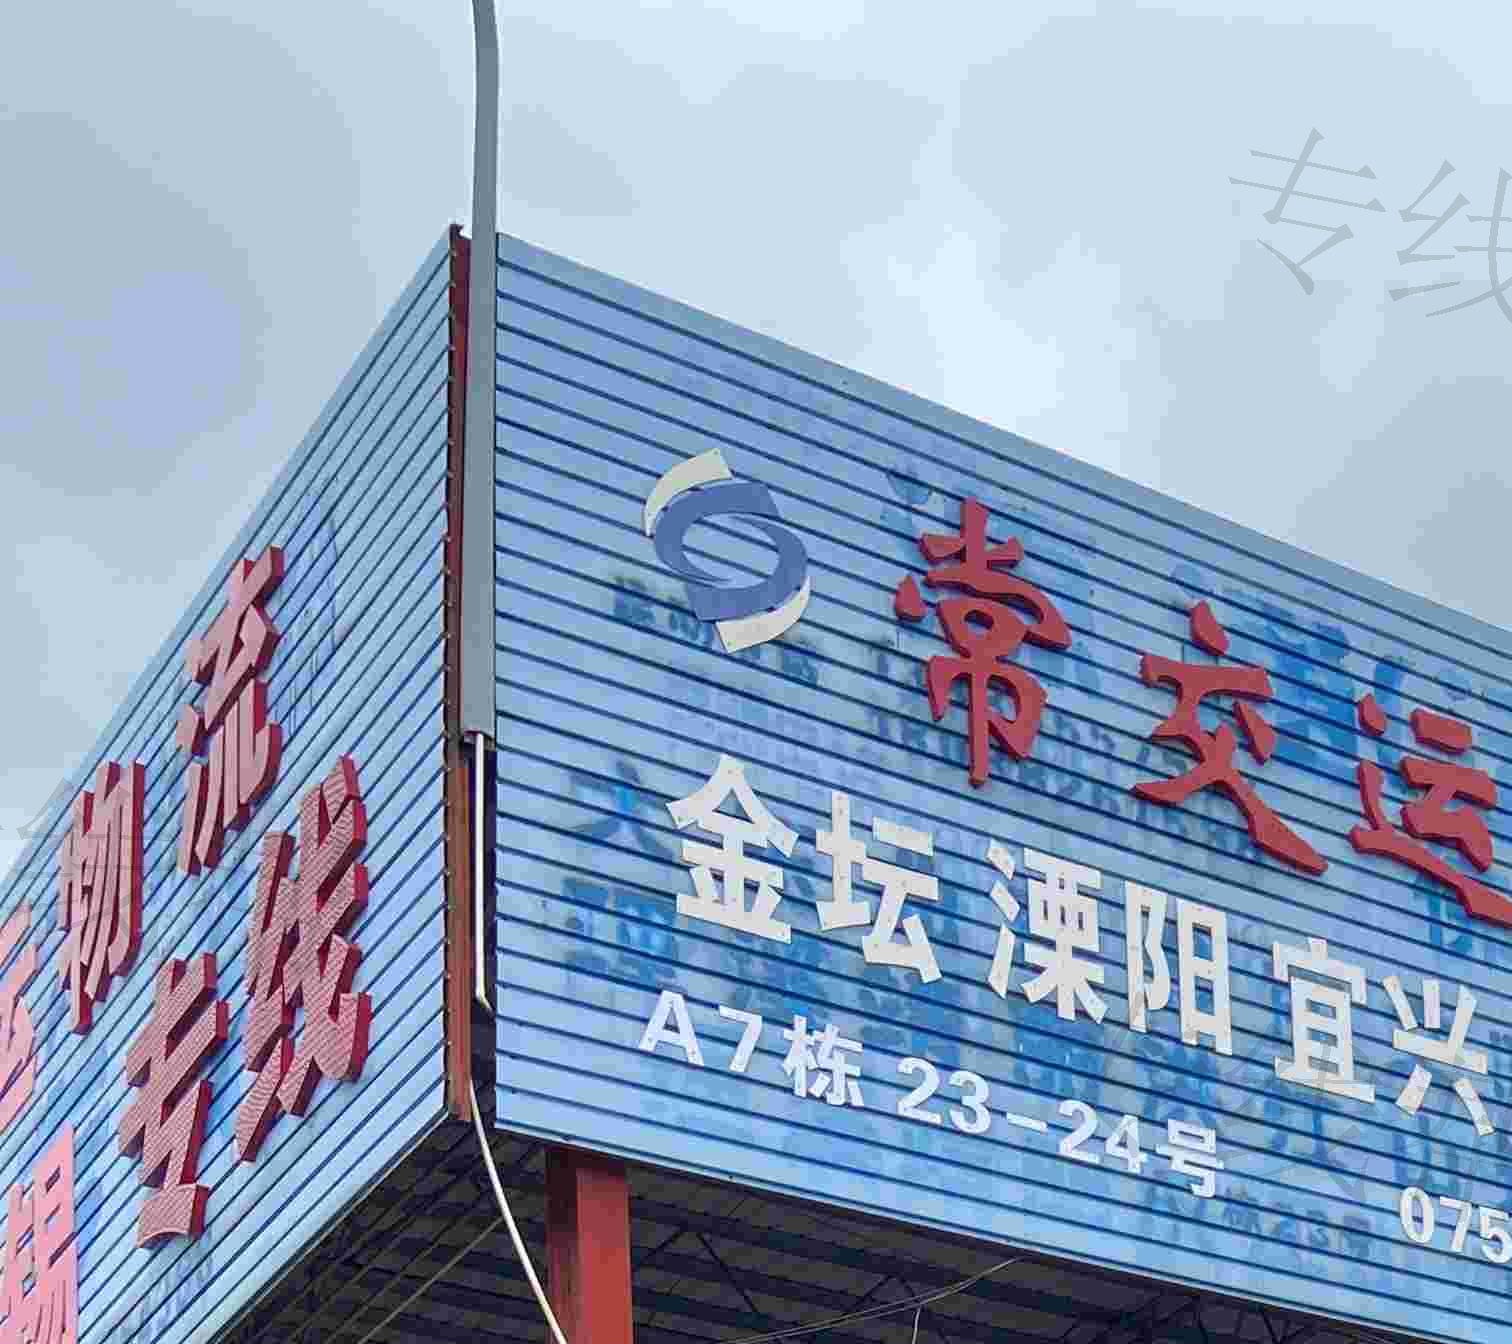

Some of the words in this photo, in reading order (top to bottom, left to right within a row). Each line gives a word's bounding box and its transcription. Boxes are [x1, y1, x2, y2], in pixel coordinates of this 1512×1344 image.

[637, 989, 864, 1109] A7栋
[665, 754, 942, 984] 金坛
[985, 840, 1233, 1057] 溧阳
[1272, 937, 1494, 1135] 宜兴
